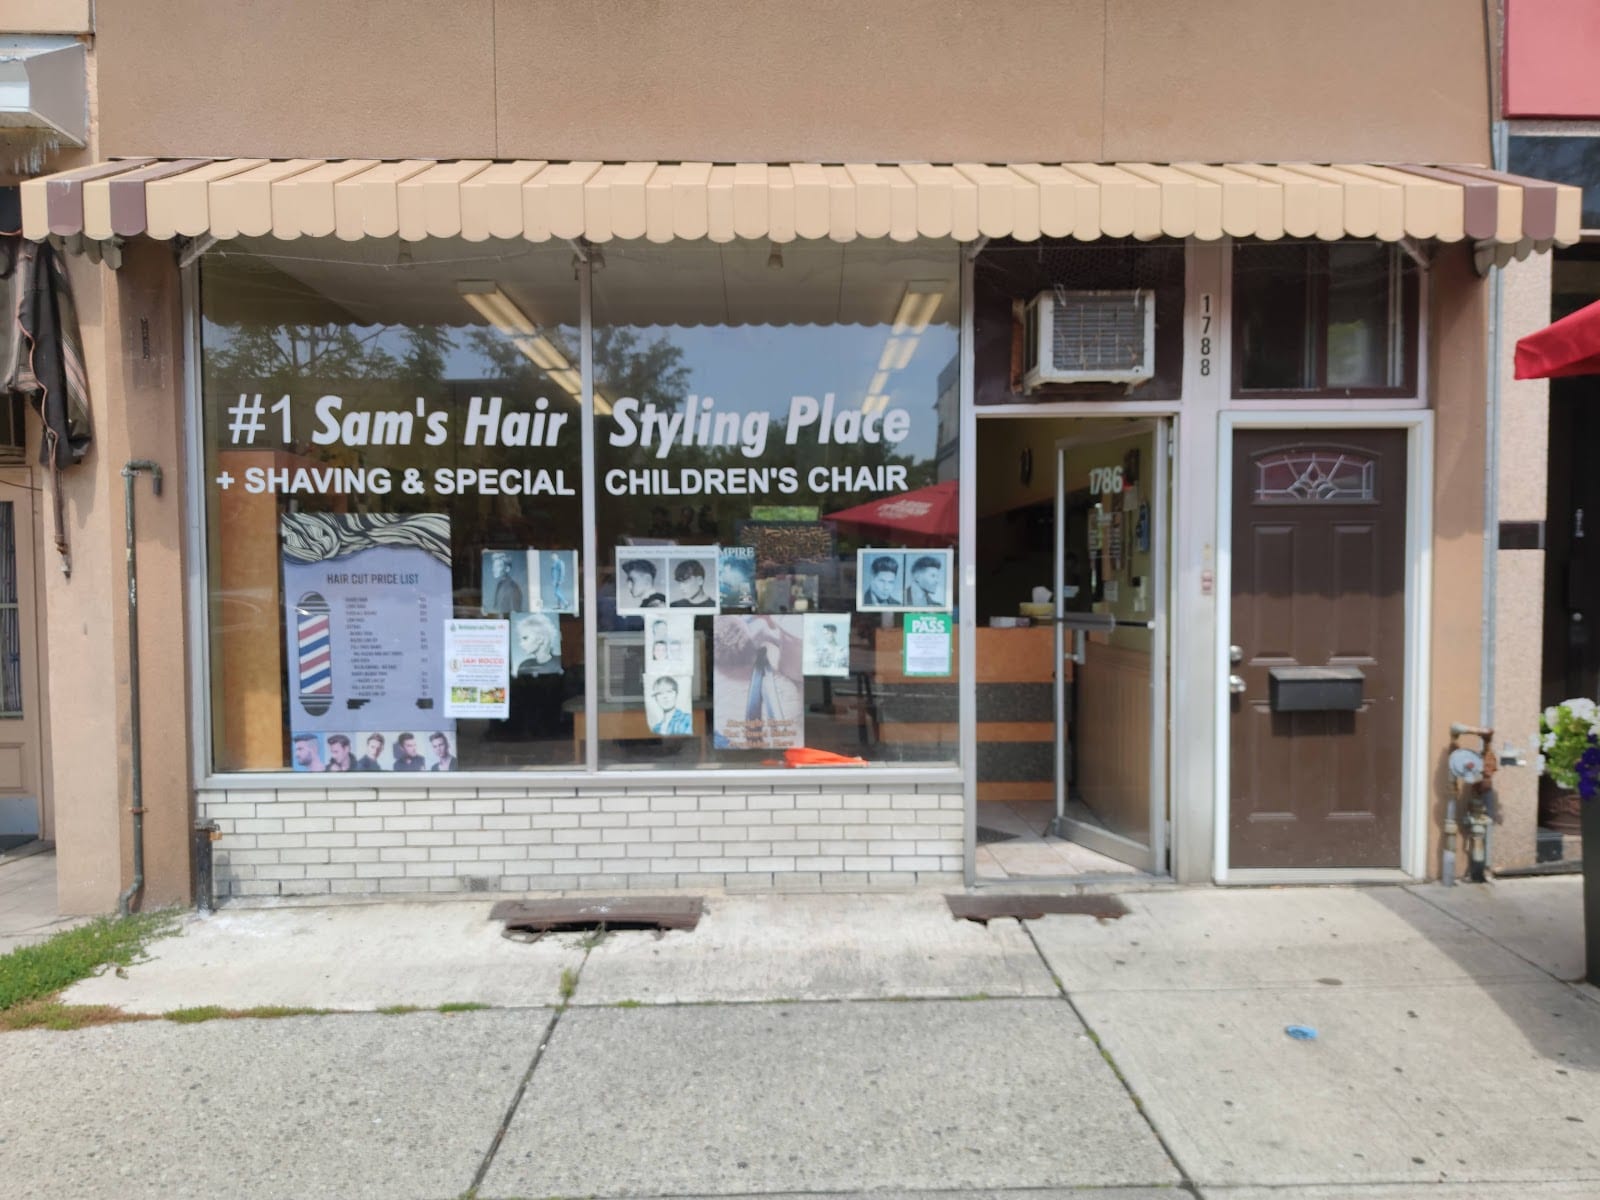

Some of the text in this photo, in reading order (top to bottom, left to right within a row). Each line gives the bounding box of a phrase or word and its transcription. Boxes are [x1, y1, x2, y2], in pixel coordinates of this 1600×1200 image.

[1200, 294, 1211, 376] 1788
[228, 392, 911, 459] #1 Sam's Hair Styling Place
[245, 467, 392, 494] SHAVING
[401, 468, 425, 494] &
[434, 468, 575, 496] SPECIAL
[605, 467, 798, 495] CHILDREN'S
[808, 465, 909, 492] CHAIR
[1089, 465, 1123, 495] 1786
[719, 547, 755, 558] MPIRE
[327, 574, 420, 584] HAIR CUT PRICE LIST
[912, 620, 945, 633] PASS
